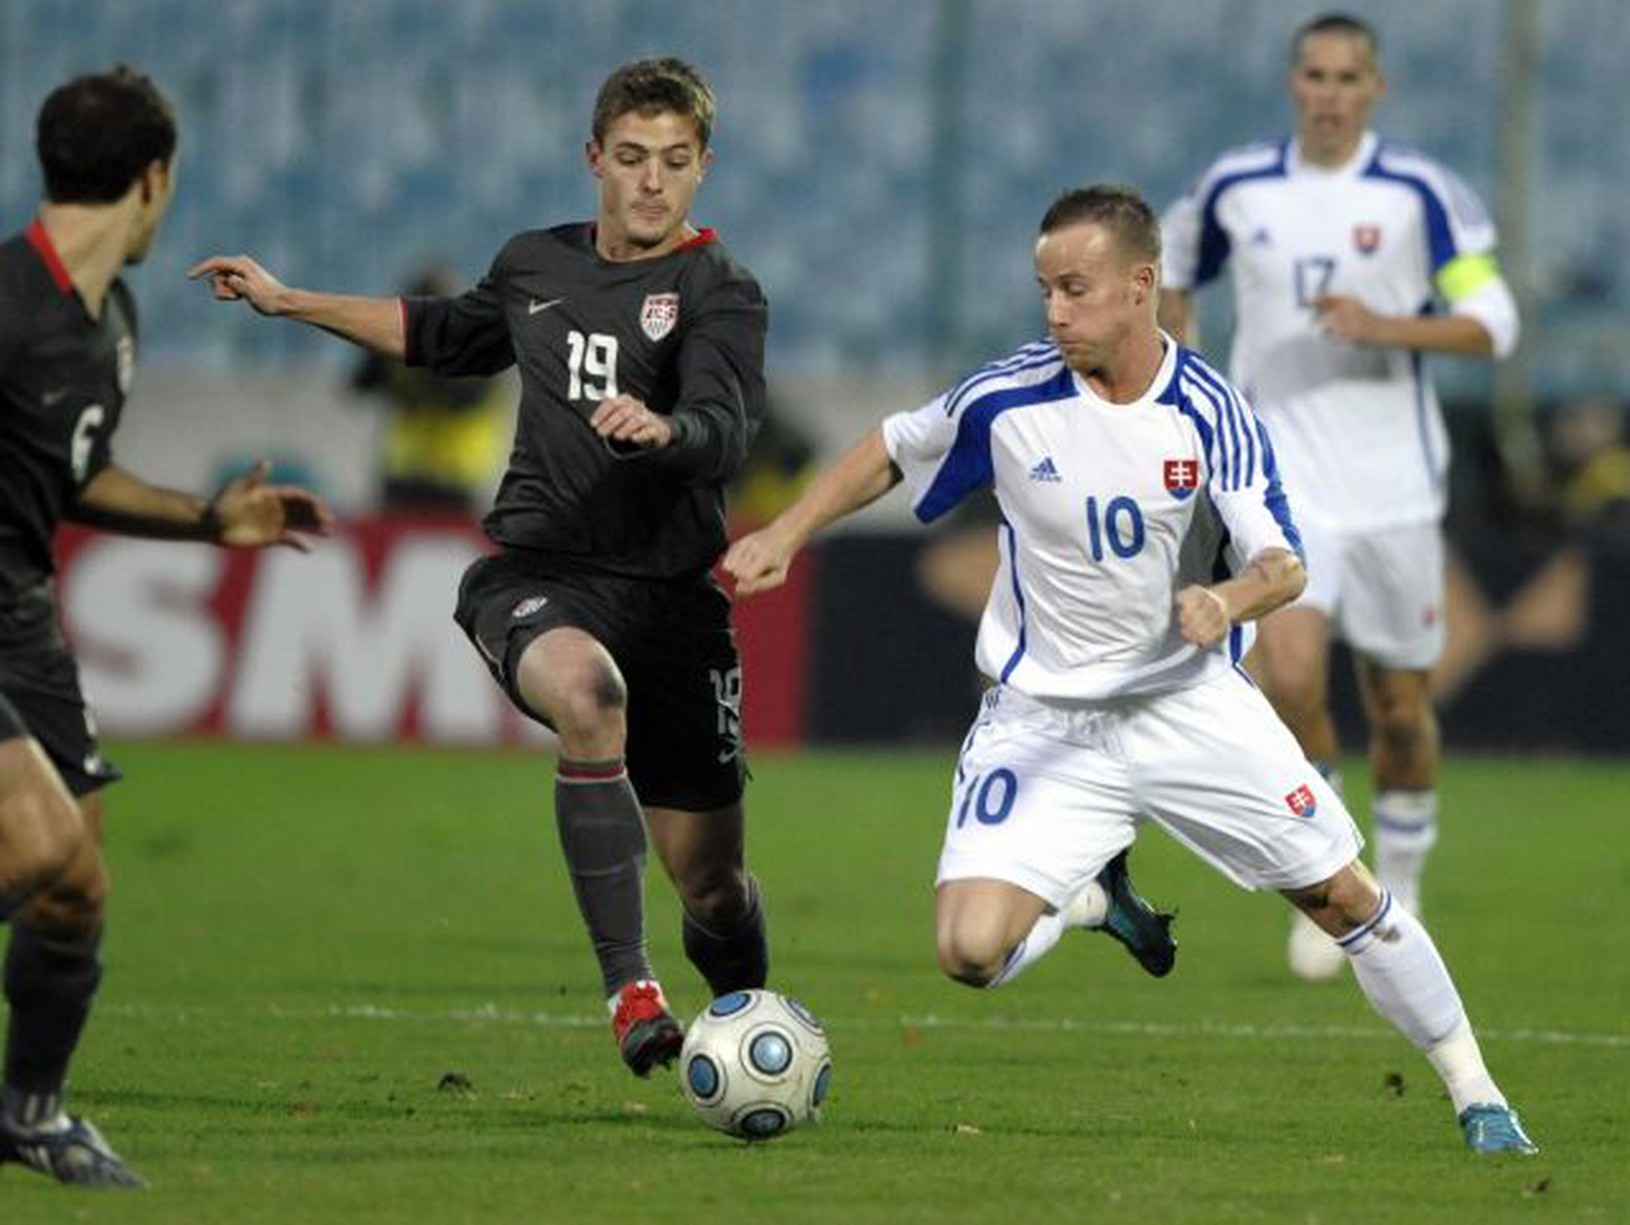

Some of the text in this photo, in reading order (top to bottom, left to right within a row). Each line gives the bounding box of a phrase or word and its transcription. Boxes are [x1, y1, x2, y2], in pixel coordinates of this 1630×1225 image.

[567, 331, 618, 401] 19
[1086, 496, 1145, 561] 10
[957, 768, 1017, 829] 10
